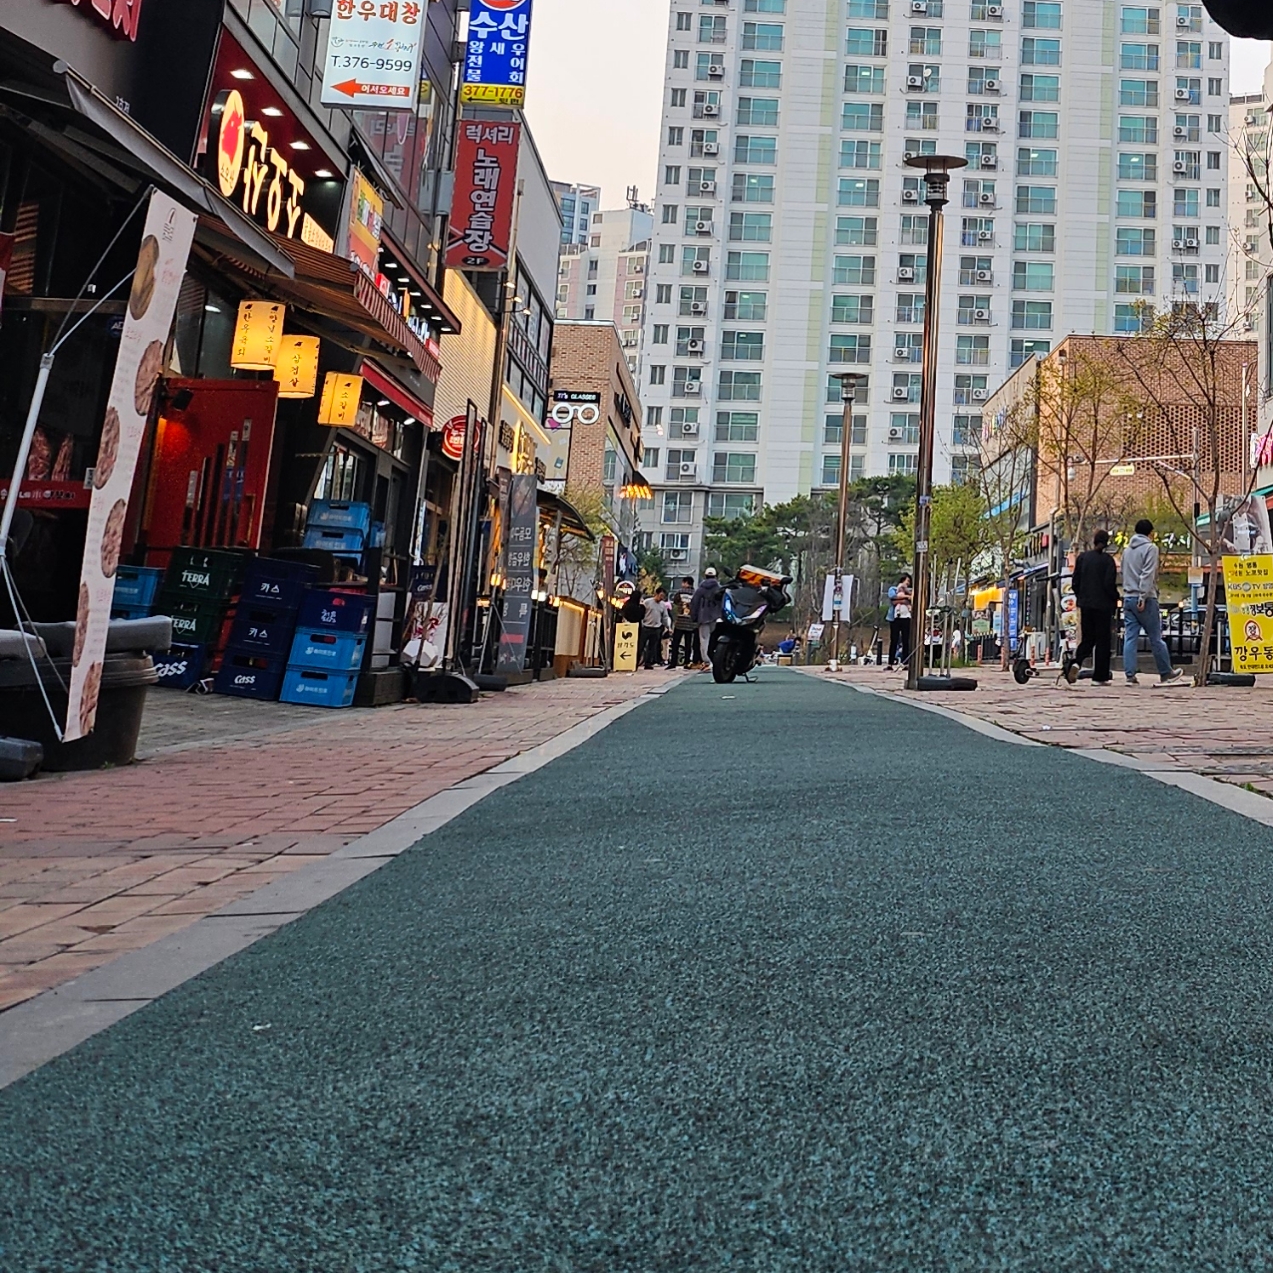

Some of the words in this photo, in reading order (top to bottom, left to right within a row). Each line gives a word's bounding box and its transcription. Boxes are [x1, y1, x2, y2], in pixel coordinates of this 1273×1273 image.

[469, 11, 530, 40] 수산
[331, 54, 412, 72] T.376-9599
[361, 84, 406, 96] 어서오세요
[463, 85, 523, 100] 377-1776
[466, 125, 515, 145] 럭셔리
[463, 148, 501, 253] 노래연습장
[466, 255, 486, 266] 2F
[182, 569, 210, 586] TERRA
[260, 582, 280, 594] 카스
[170, 615, 197, 631] TERRA
[248, 628, 268, 638] 카스
[234, 675, 256, 684] Cass
